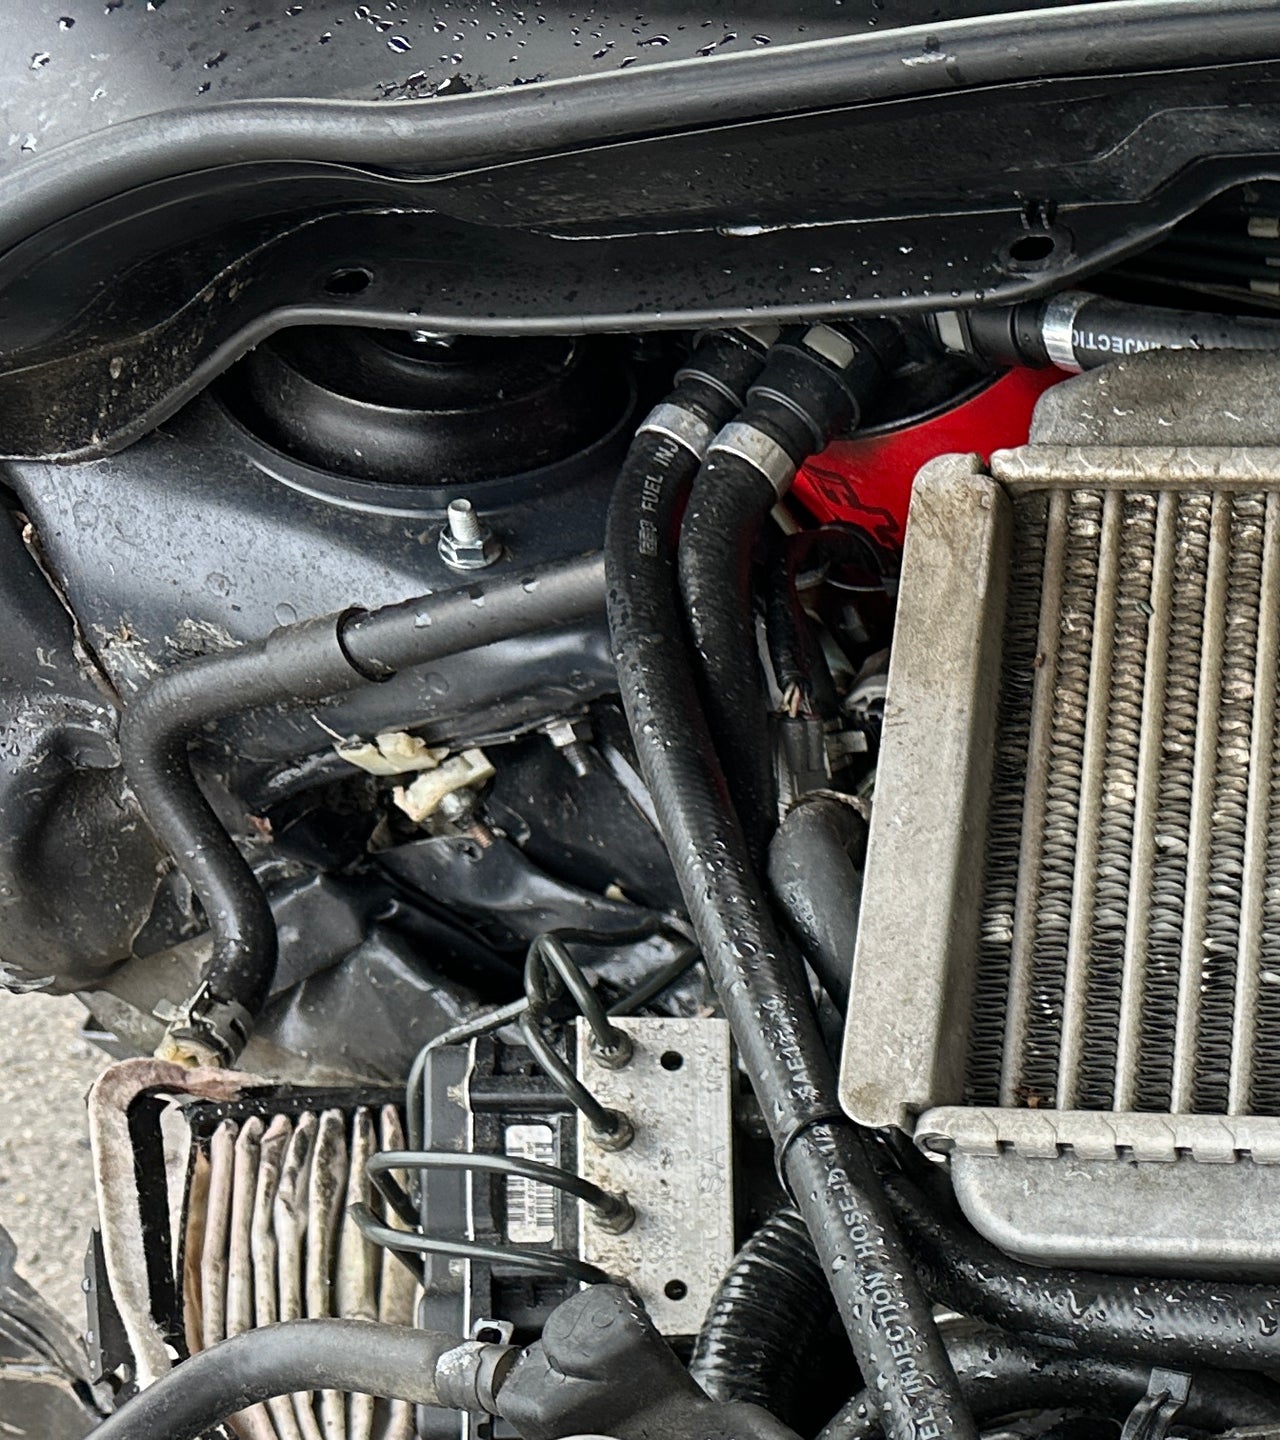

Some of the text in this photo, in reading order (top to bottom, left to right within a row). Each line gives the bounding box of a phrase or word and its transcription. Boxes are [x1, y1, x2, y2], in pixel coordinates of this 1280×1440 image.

[641, 474, 664, 513] FUEL
[838, 1196, 876, 1259] HOSE
[864, 1271, 924, 1396] INJECTION
